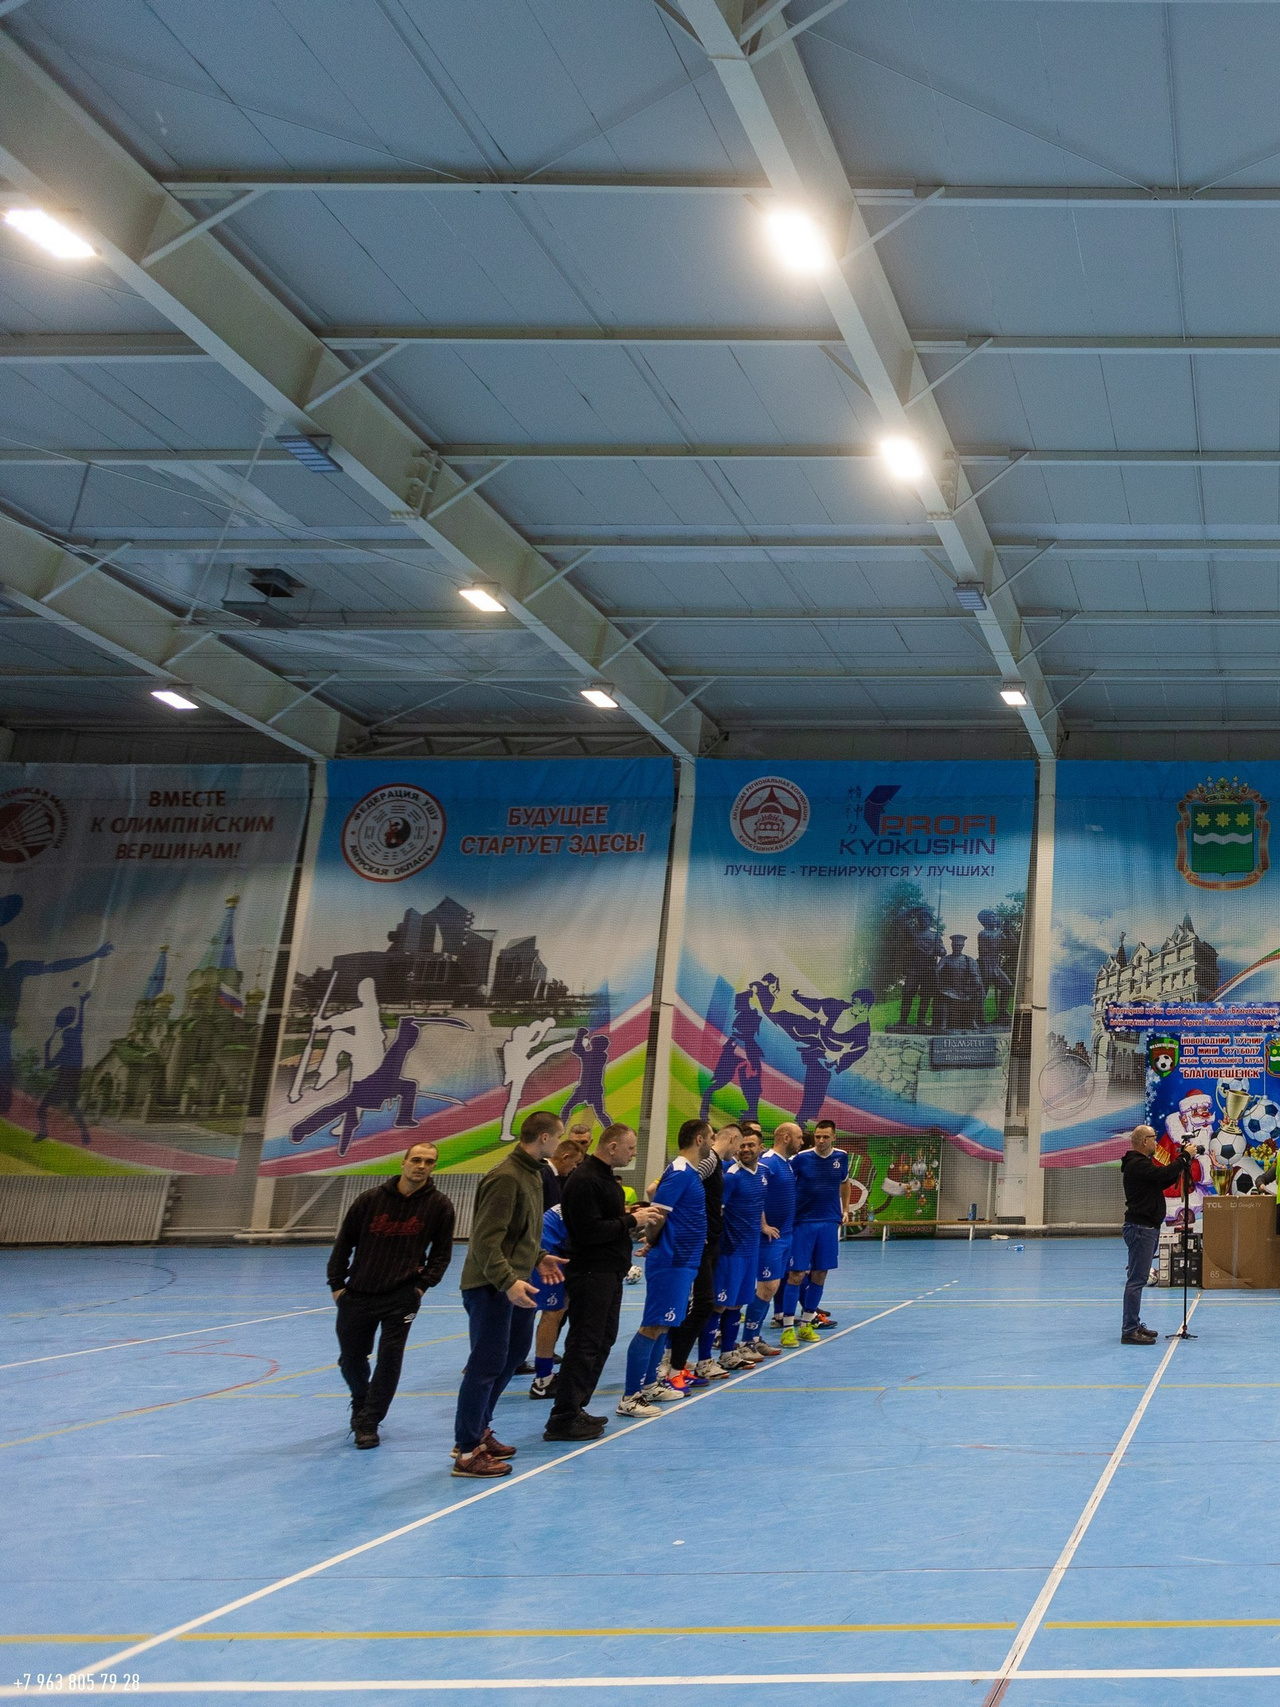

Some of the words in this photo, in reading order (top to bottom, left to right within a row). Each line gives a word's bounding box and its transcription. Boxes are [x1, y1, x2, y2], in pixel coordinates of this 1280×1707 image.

[149, 790, 226, 807] ВМЕСТЕ
[354, 789, 419, 820] ФЕДЕРАЦИЯ
[422, 800, 439, 820] УШУ
[90, 817, 105, 833] К
[110, 813, 274, 833] ОЛИМПИЙСКИМ
[507, 805, 609, 829] БУДУЩЕЕ
[879, 815, 997, 835] PROFI
[114, 842, 243, 859] ВЕРШИНАМ!
[460, 834, 565, 855] СТАРТУЕТ
[567, 832, 646, 857] ЗДЕСЬ!
[838, 839, 996, 856] KYOKUSHIN
[349, 844, 389, 875] АМУРСКАЯ
[393, 845, 435, 875] ОБЛАСТЬ
[724, 865, 786, 876] ЛУЧШИЕ
[800, 865, 909, 877] ТРЕНИРУЮТСЯ
[914, 866, 923, 876] У
[926, 865, 995, 876] ЛУЧШИХ!
[1180, 1035, 1231, 1045] НОВОГОДНИЙ
[1234, 1036, 1264, 1045] ТУРНИР
[1183, 1047, 1195, 1055] ПО
[1197, 1047, 1220, 1055] МИНИ
[1222, 1046, 1261, 1055] ФУТБОЛУ
[1179, 1056, 1200, 1064] КУБОК
[1201, 1056, 1243, 1065] ФУТБОЛЬНОГО
[1244, 1056, 1264, 1064] КЛУБА
[1210, 1270, 1220, 1278] 65
